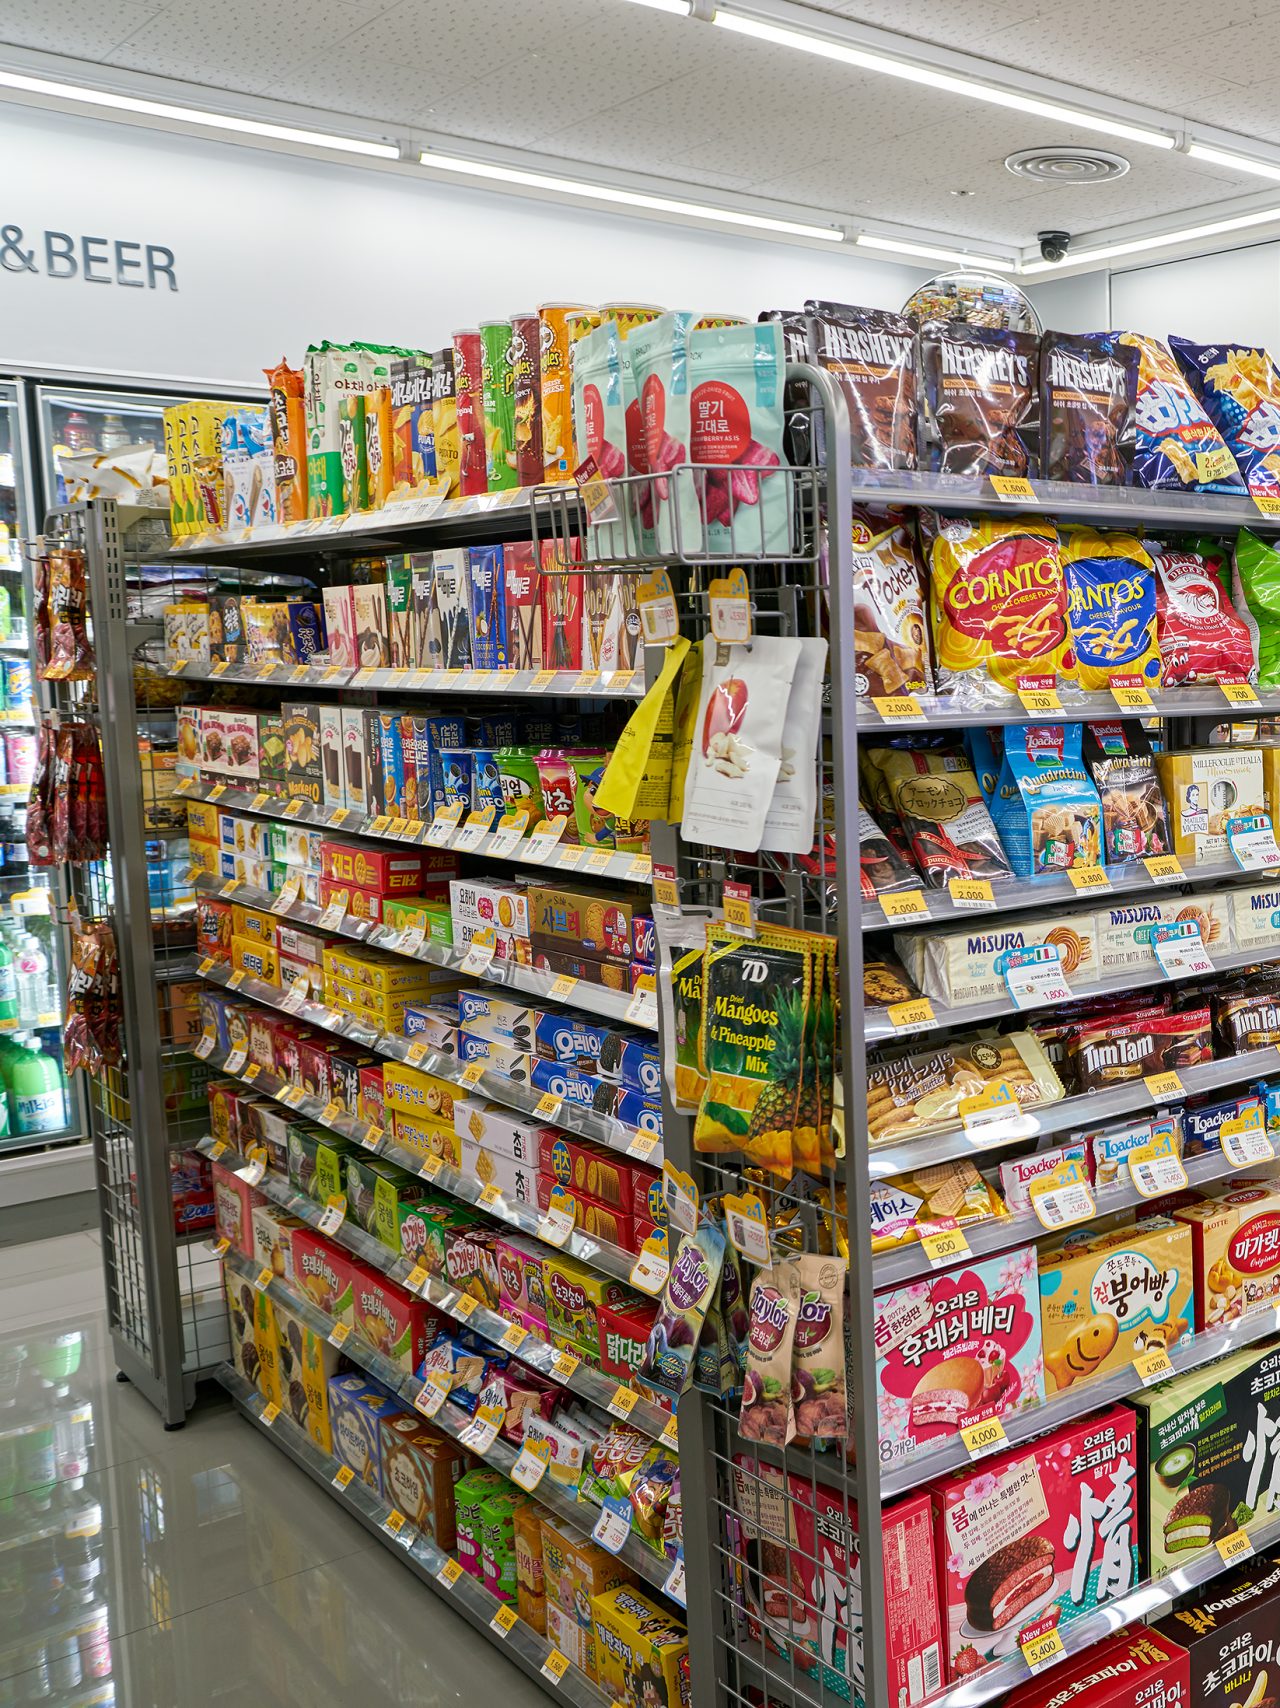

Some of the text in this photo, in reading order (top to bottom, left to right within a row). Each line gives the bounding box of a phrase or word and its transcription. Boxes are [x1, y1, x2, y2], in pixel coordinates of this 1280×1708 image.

[825, 324, 913, 369] HERSHEY'S
[699, 400, 724, 418] 딸기
[696, 420, 730, 434] 그대로
[1003, 484, 1026, 494] 1,500
[1018, 679, 1039, 689] New
[1112, 677, 1130, 687] New
[1219, 675, 1236, 685] New
[1034, 697, 1050, 707] 700
[1126, 694, 1142, 704] 700
[1232, 690, 1248, 700] 700
[886, 703, 913, 713] 2,000
[1090, 725, 1123, 735] Loacker
[1025, 735, 1064, 747] Loacker
[288, 781, 312, 796] Market
[908, 784, 951, 796] アーモンド
[1022, 769, 1087, 794] Quadratini
[906, 797, 964, 809] ブロックチョコ
[1182, 823, 1209, 834] VICENZI
[331, 853, 353, 881] 제크
[1154, 865, 1176, 875] 3,800
[1081, 874, 1103, 884] 3,800
[658, 890, 674, 902] 5,000
[958, 891, 984, 900] 2,000
[727, 910, 746, 924] 4,000
[892, 903, 918, 913] 2,000
[542, 907, 580, 938] 사브레
[741, 959, 770, 984] 7D
[1189, 962, 1208, 972] 1,800
[729, 994, 745, 1005] Dried
[1043, 989, 1065, 1001] 1,800
[465, 999, 491, 1018] 오레오
[714, 995, 780, 1027] Mangoes
[901, 1011, 926, 1023] 1,500
[555, 1031, 600, 1057] 오레오
[718, 1024, 777, 1053] Pineapple
[466, 1039, 491, 1058] 오레오
[978, 1052, 997, 1063] 25%
[745, 1054, 769, 1075] Mix
[888, 1052, 955, 1096] Pretzels
[548, 1074, 594, 1104] 오레오
[922, 1074, 946, 1093] butter
[1157, 1081, 1178, 1093] 2,500
[990, 1084, 1012, 1103] 1+1
[18, 1099, 55, 1116] Milkis
[542, 1100, 558, 1111] 1,500
[1189, 1109, 1237, 1134] Loacker
[636, 1138, 653, 1149] 1,500
[1100, 1133, 1150, 1158] Loacker
[553, 1152, 572, 1178] 리츠
[1012, 1156, 1062, 1183] Loacker
[1058, 1163, 1079, 1184] 2+1
[881, 1218, 909, 1234] Original
[1207, 1218, 1230, 1230] LOTTE
[400, 1220, 427, 1250] 고래밥
[935, 1240, 956, 1253] 800
[676, 1246, 709, 1292] Taylor
[1250, 1252, 1280, 1269] Original
[301, 1253, 340, 1293] 후레쉬베리
[501, 1267, 520, 1292] 칸쵸
[551, 1276, 585, 1309] 초코송이
[1093, 1281, 1109, 1304] 참
[1108, 1266, 1170, 1319] 붕어빵
[751, 1286, 790, 1331] Taylor
[934, 1290, 979, 1319] 오리온
[361, 1291, 397, 1337] 후레쉬베리
[887, 1305, 907, 1323] 2017년
[890, 1305, 921, 1335] 한정판
[874, 1313, 891, 1348] 봄
[899, 1304, 1015, 1367] 후레쉬베리
[559, 1362, 571, 1373] 1,000
[1146, 1359, 1166, 1374] 4,200
[618, 1397, 631, 1407] 1,400
[961, 1414, 981, 1429] New
[1157, 1419, 1178, 1437] 국내산
[971, 1428, 998, 1446] 4,000
[1083, 1427, 1116, 1452] 오리온
[1069, 1433, 1133, 1477] 초코파이
[1093, 1461, 1113, 1479] 딸기
[978, 1480, 1021, 1517] 만나는 특별한
[618, 1504, 633, 1517] 2+1
[1063, 1456, 1138, 1607] 情
[1226, 1539, 1246, 1555] 6,000
[616, 1591, 654, 1620] 계란과자
[595, 1619, 633, 1666] 계란과자
[1021, 1626, 1042, 1645] New
[1029, 1638, 1057, 1663] 5,400
[1218, 1631, 1252, 1661] 오리온
[551, 1658, 564, 1672] 1,500
[1202, 1640, 1275, 1698] 초코파이
[1223, 1667, 1253, 1695] 바나나
[1135, 1677, 1166, 1704] 오리온
